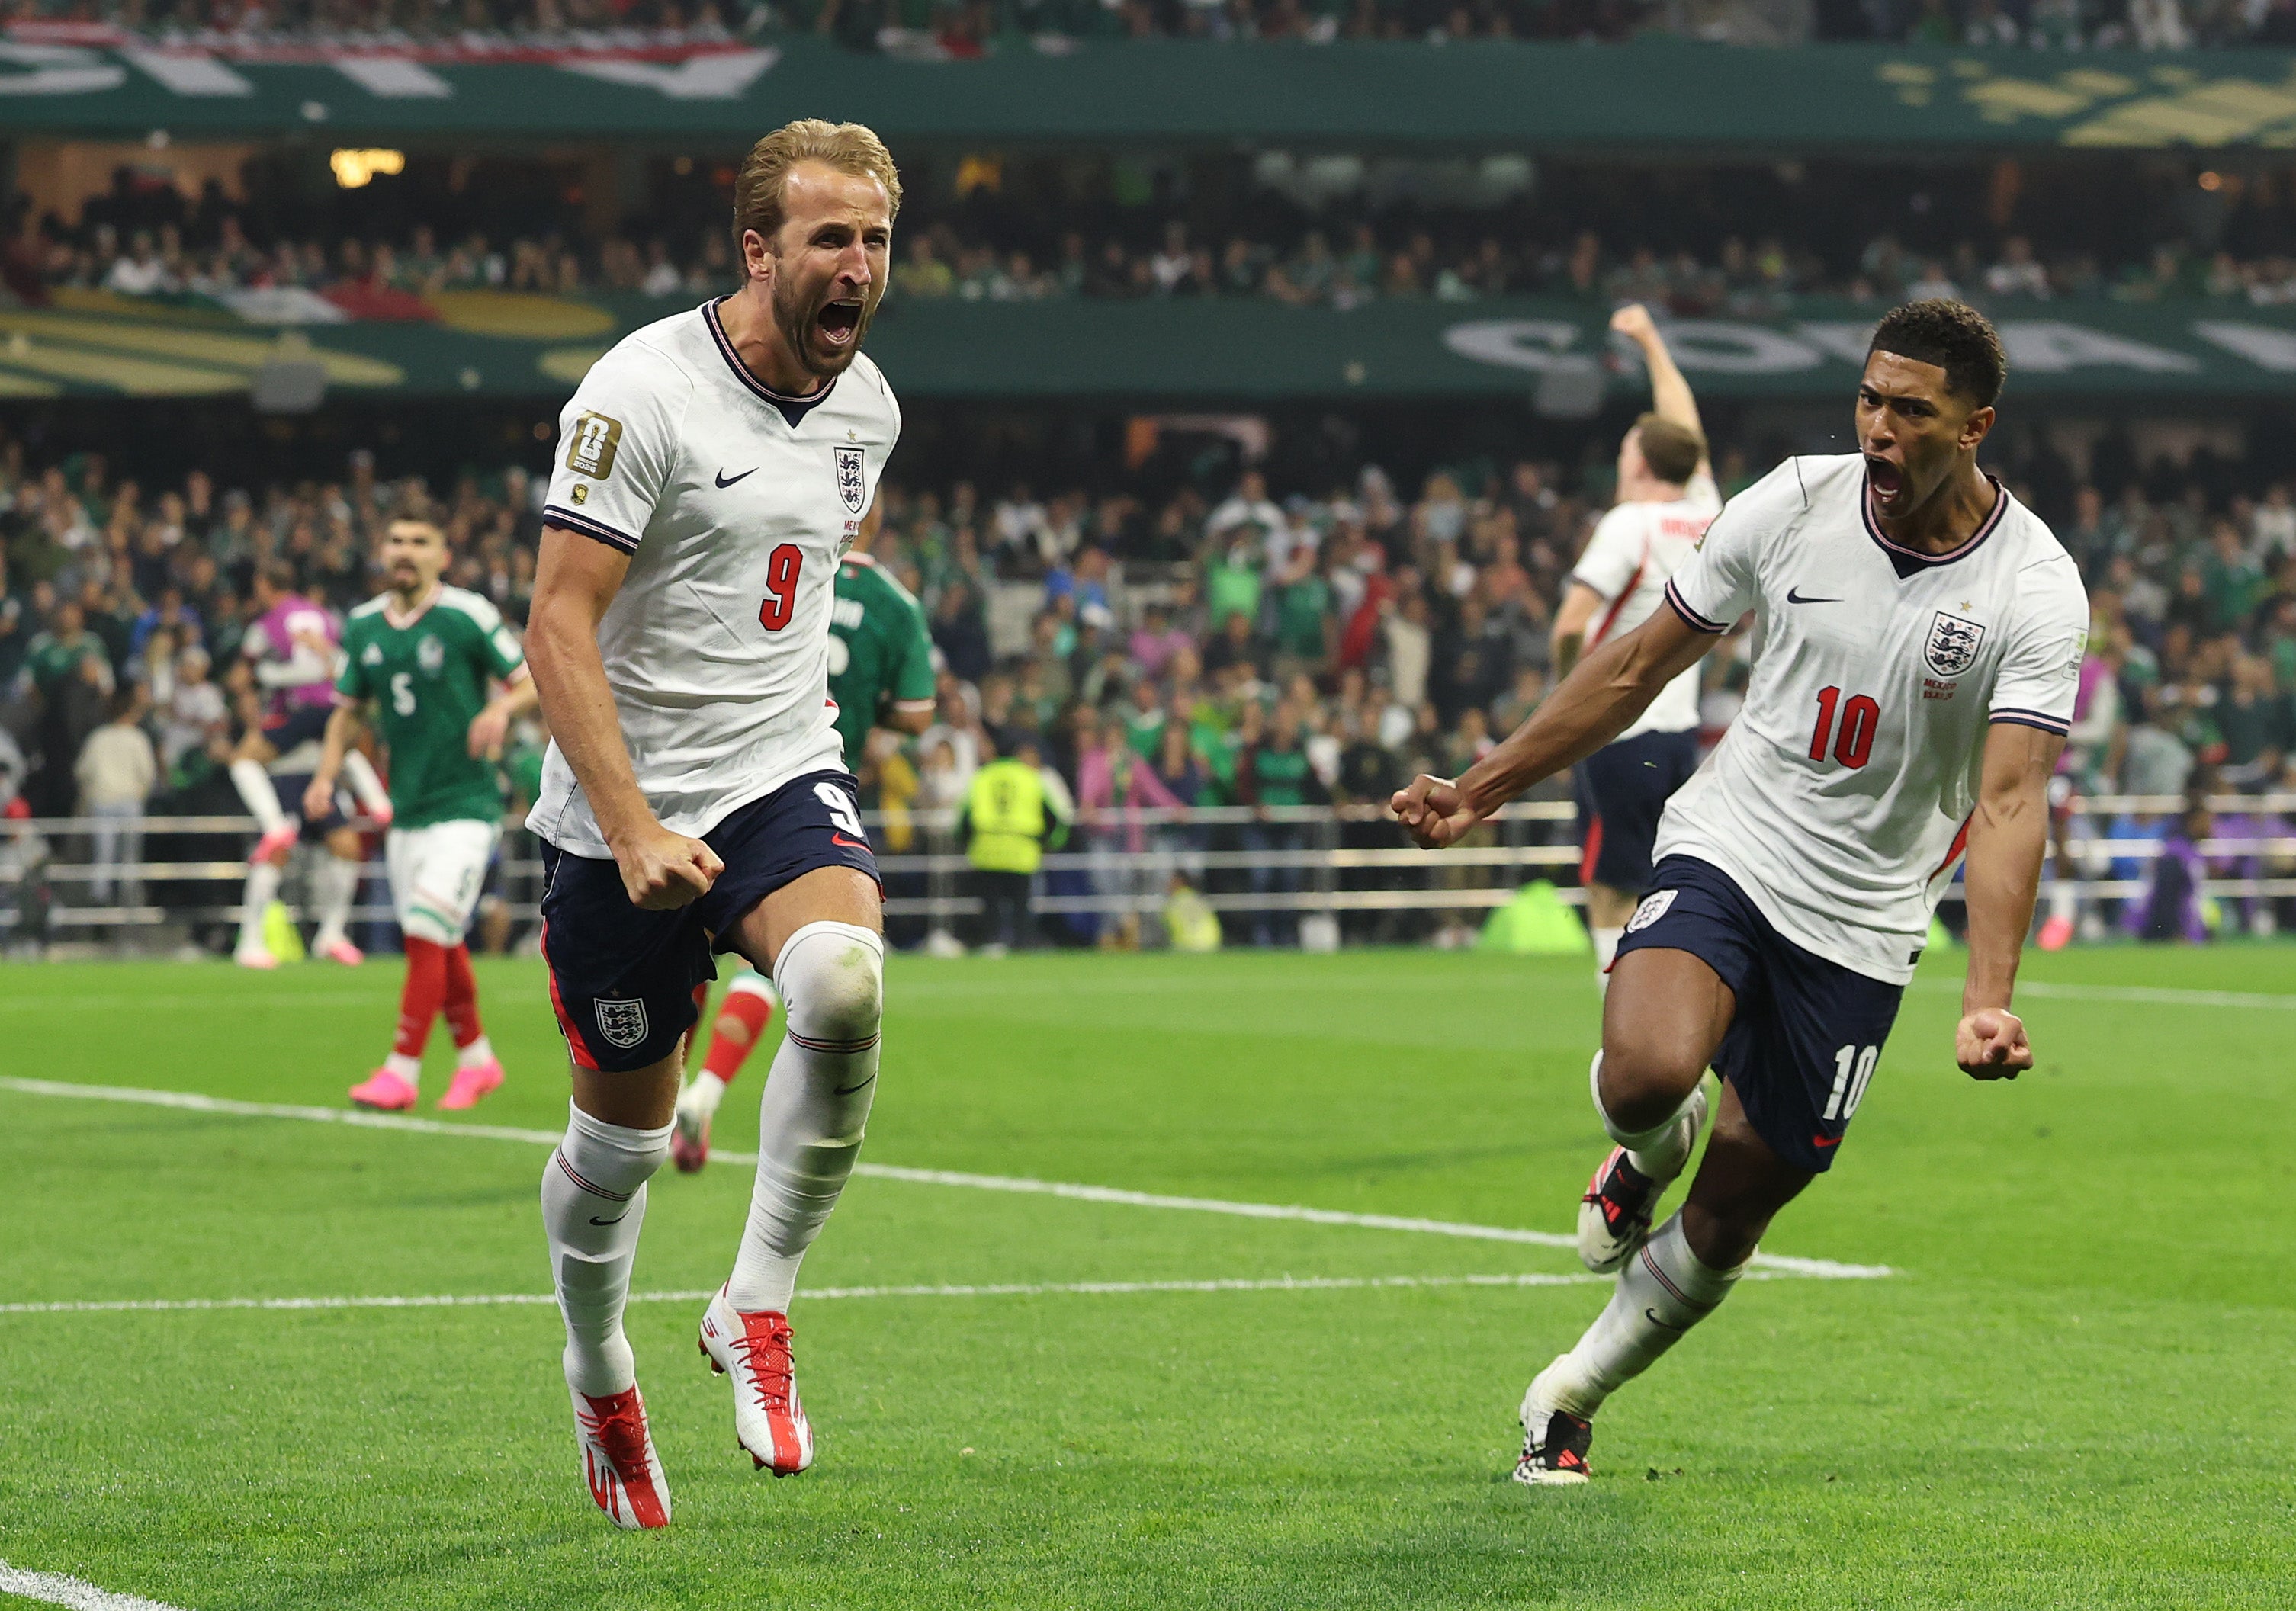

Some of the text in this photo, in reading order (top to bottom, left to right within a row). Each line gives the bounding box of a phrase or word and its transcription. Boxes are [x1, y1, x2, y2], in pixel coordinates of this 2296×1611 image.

[573, 461, 597, 473] 2026
[759, 543, 804, 631] 9
[1808, 685, 1881, 769] 10
[812, 781, 865, 838] 9
[1822, 1044, 1879, 1122] 10
